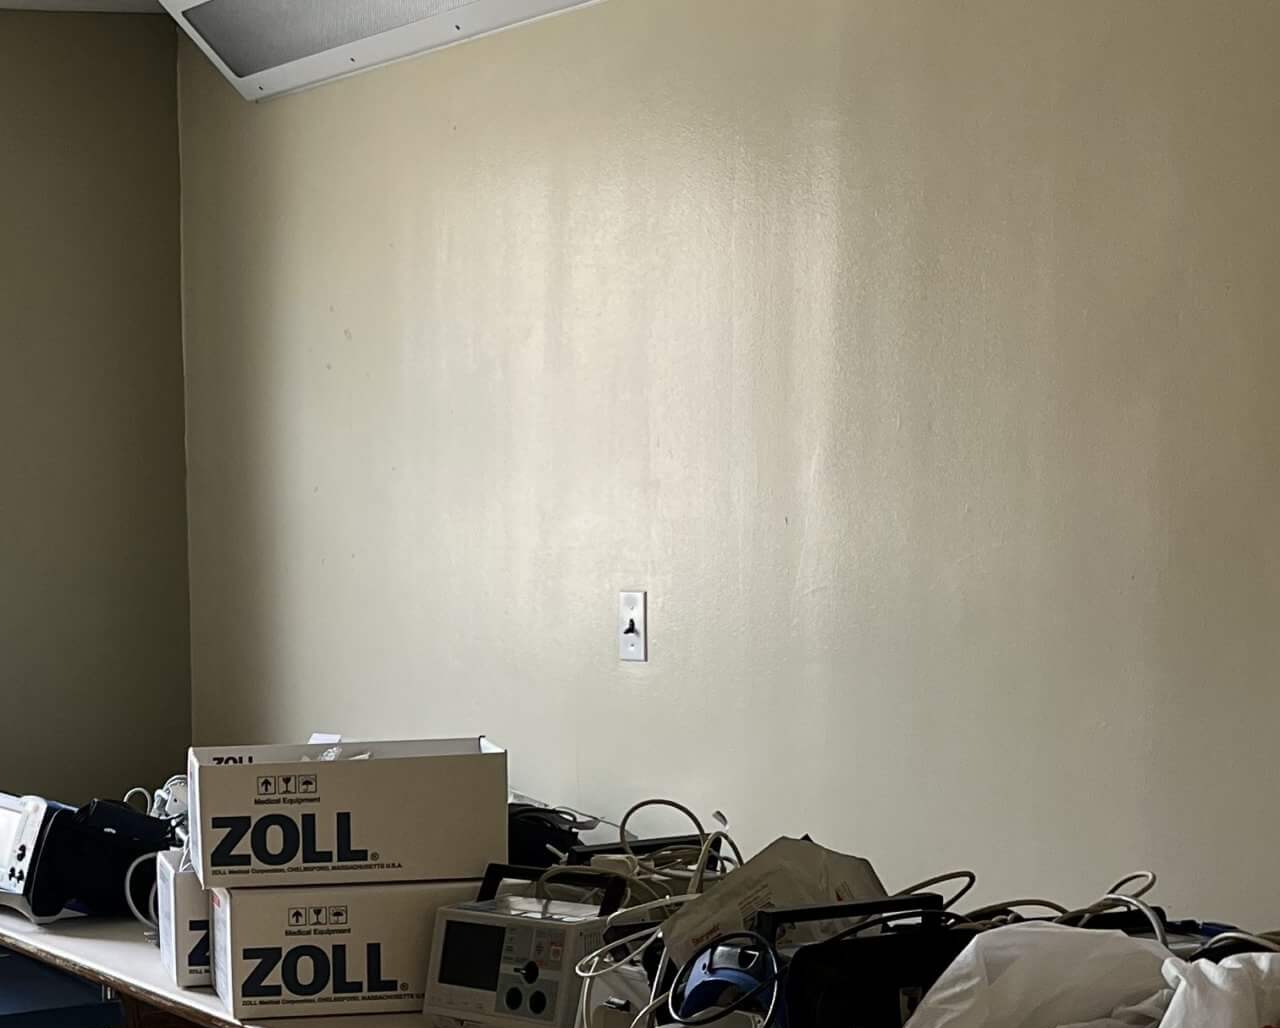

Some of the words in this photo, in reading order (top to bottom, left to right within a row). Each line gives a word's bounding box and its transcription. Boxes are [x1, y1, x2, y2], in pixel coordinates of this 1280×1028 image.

[283, 797, 321, 805] Equipment
[210, 811, 369, 867] ZOLL
[313, 928, 352, 936] Equipment
[241, 942, 398, 998] ZOLL
